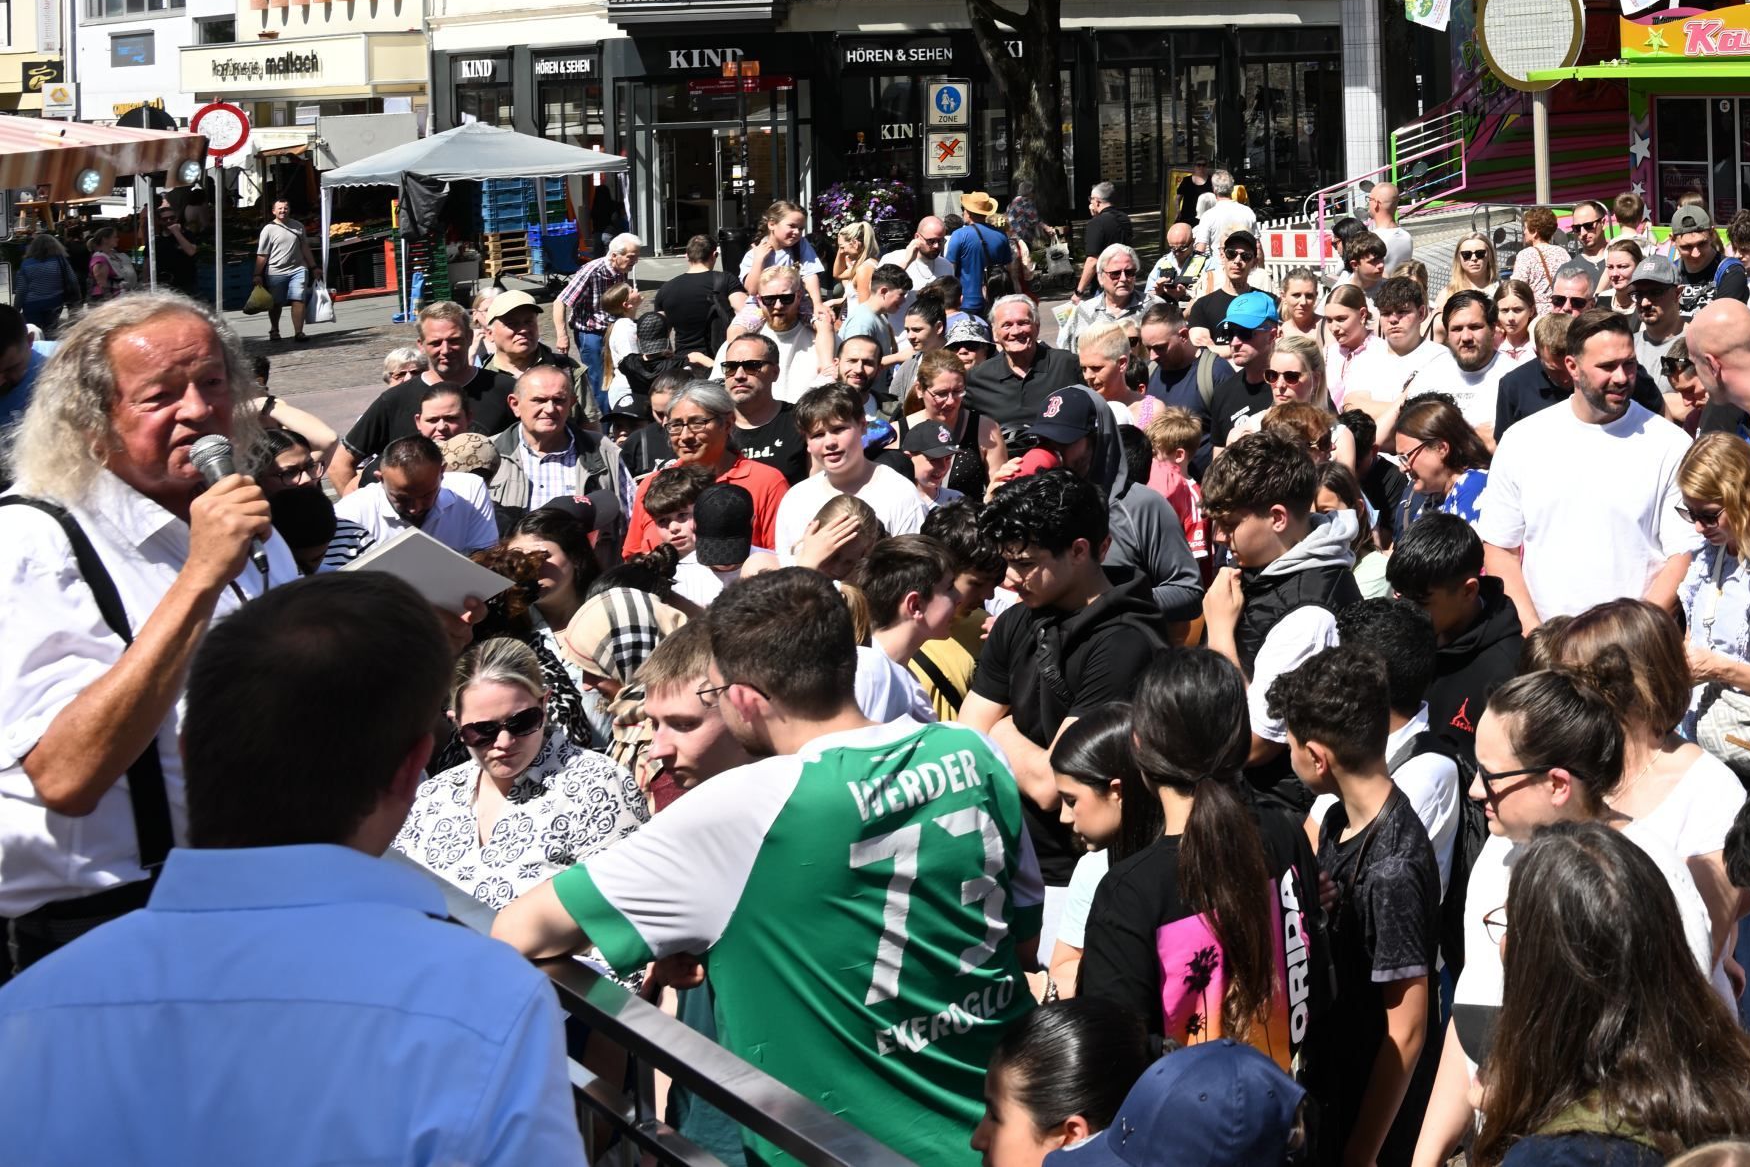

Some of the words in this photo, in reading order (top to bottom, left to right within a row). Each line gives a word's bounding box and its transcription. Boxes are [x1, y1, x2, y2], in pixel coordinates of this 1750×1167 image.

[265, 49, 318, 75] mallach
[847, 47, 893, 63] HÖREN
[896, 48, 907, 61] &
[909, 48, 953, 62] SEHEN
[462, 60, 493, 78] KIND
[535, 60, 558, 75] HÖREN
[559, 60, 567, 74] &
[567, 60, 591, 74] SEHEN
[938, 115, 958, 123] ZONE
[881, 124, 924, 139] KIN
[847, 749, 982, 822] WERDER
